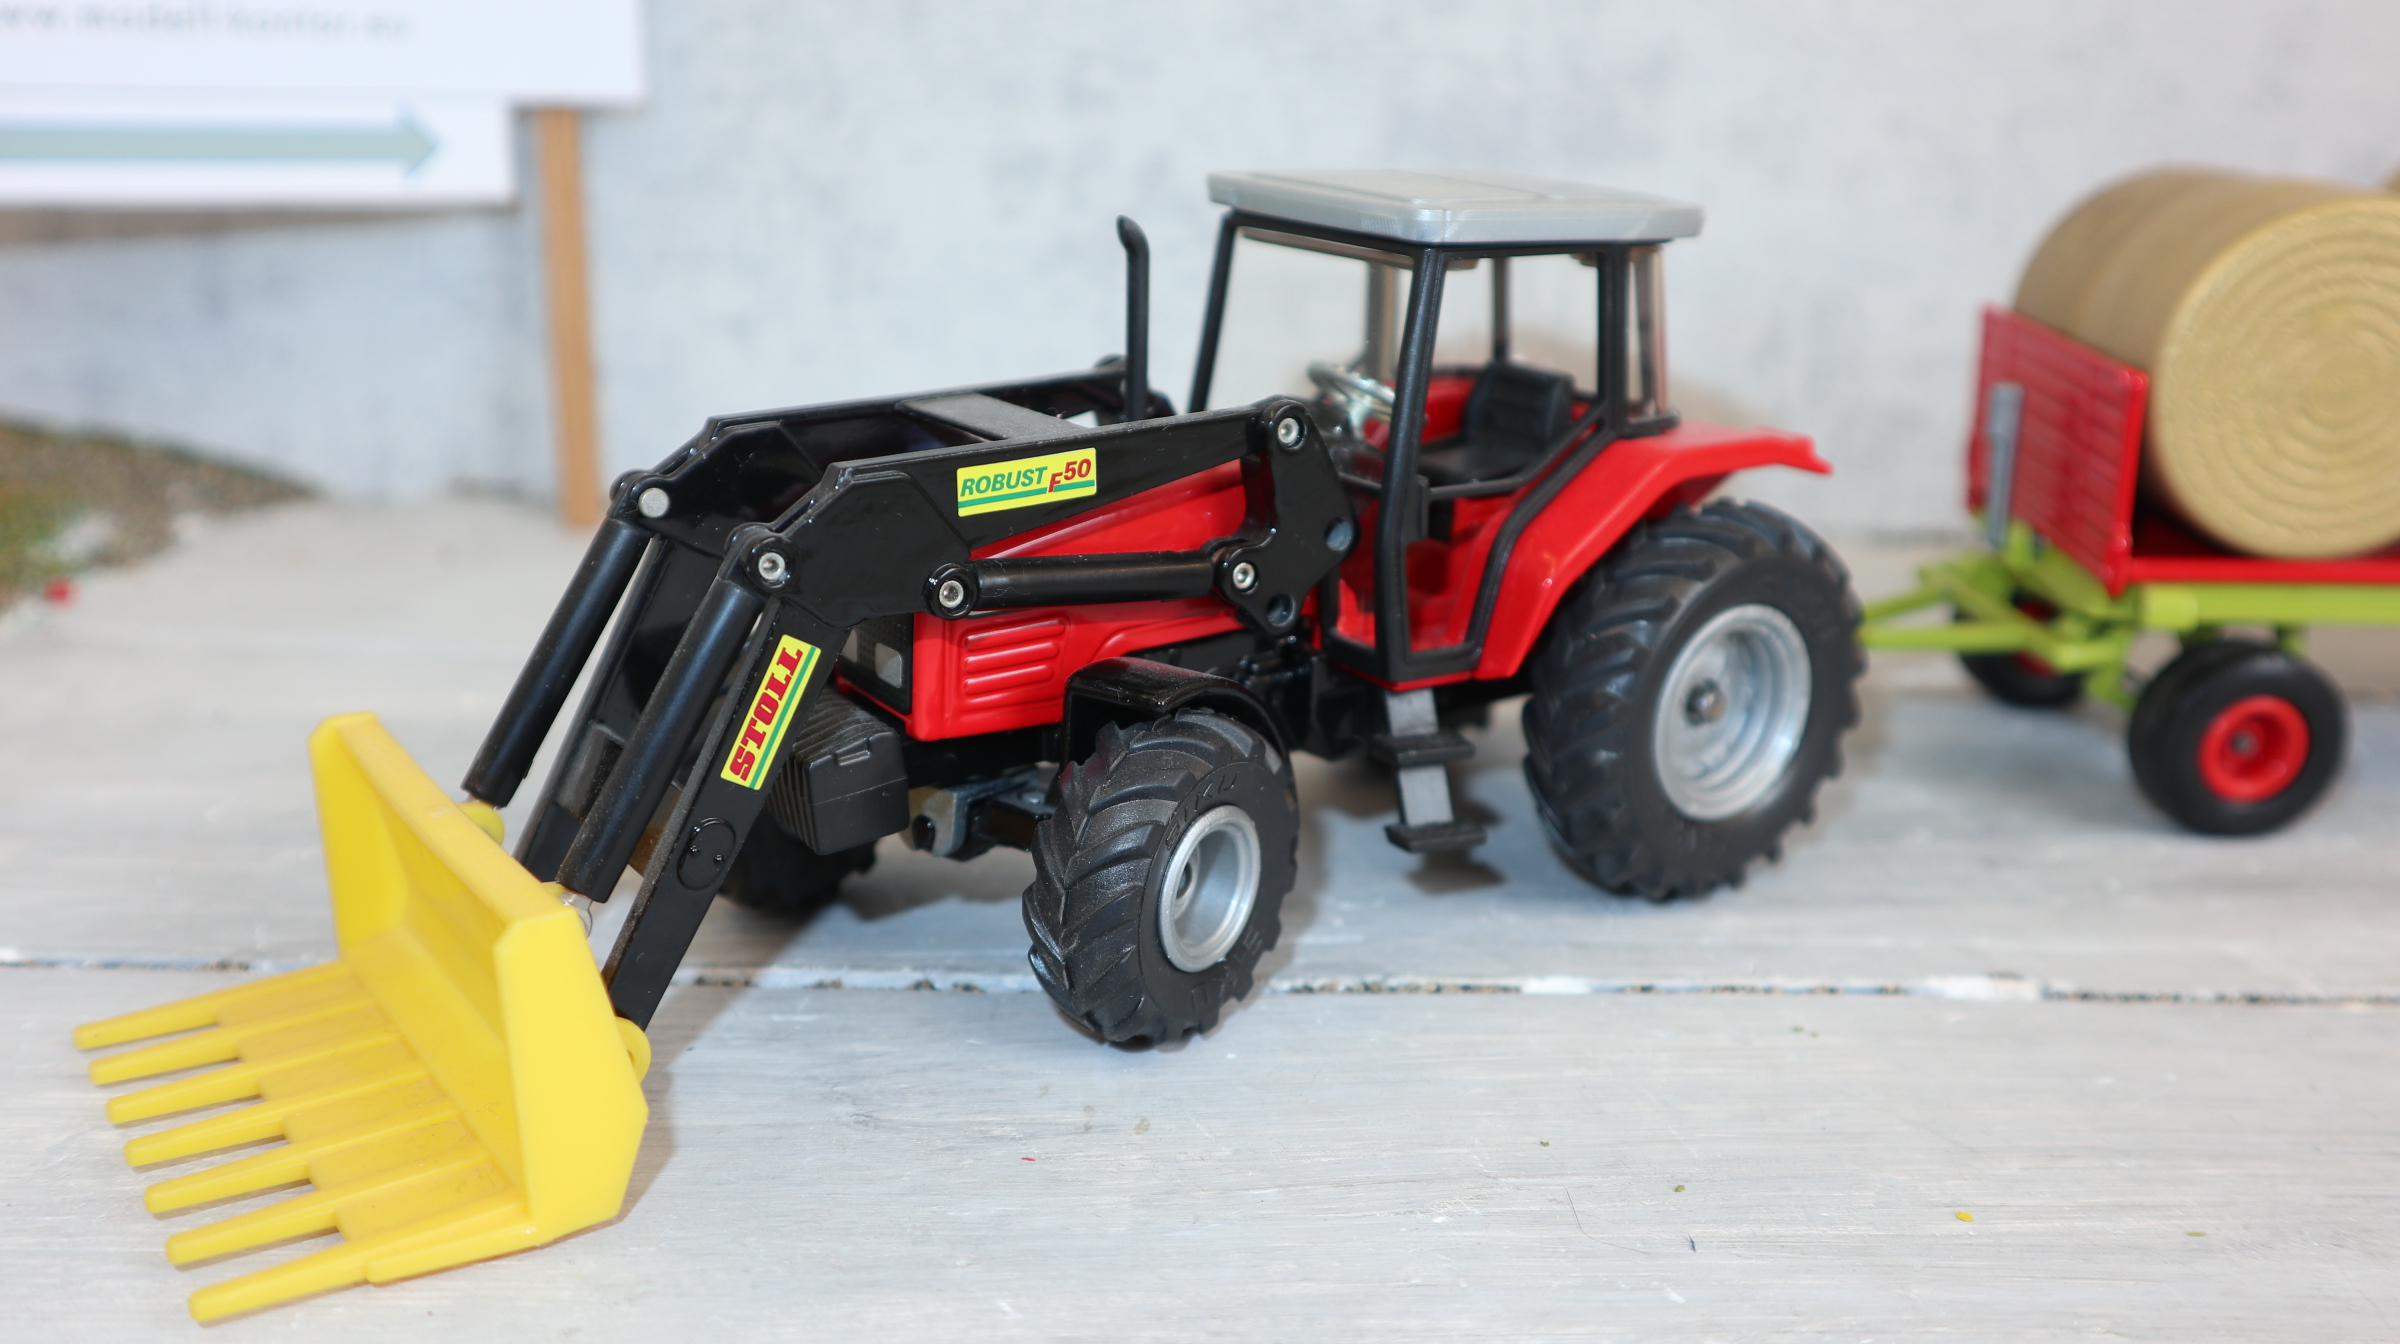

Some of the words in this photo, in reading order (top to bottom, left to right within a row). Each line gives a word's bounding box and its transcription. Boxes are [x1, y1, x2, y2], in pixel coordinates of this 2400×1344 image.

[960, 466, 1048, 497] ROBUST
[1048, 458, 1091, 492] F50
[729, 647, 803, 782] STOLL
